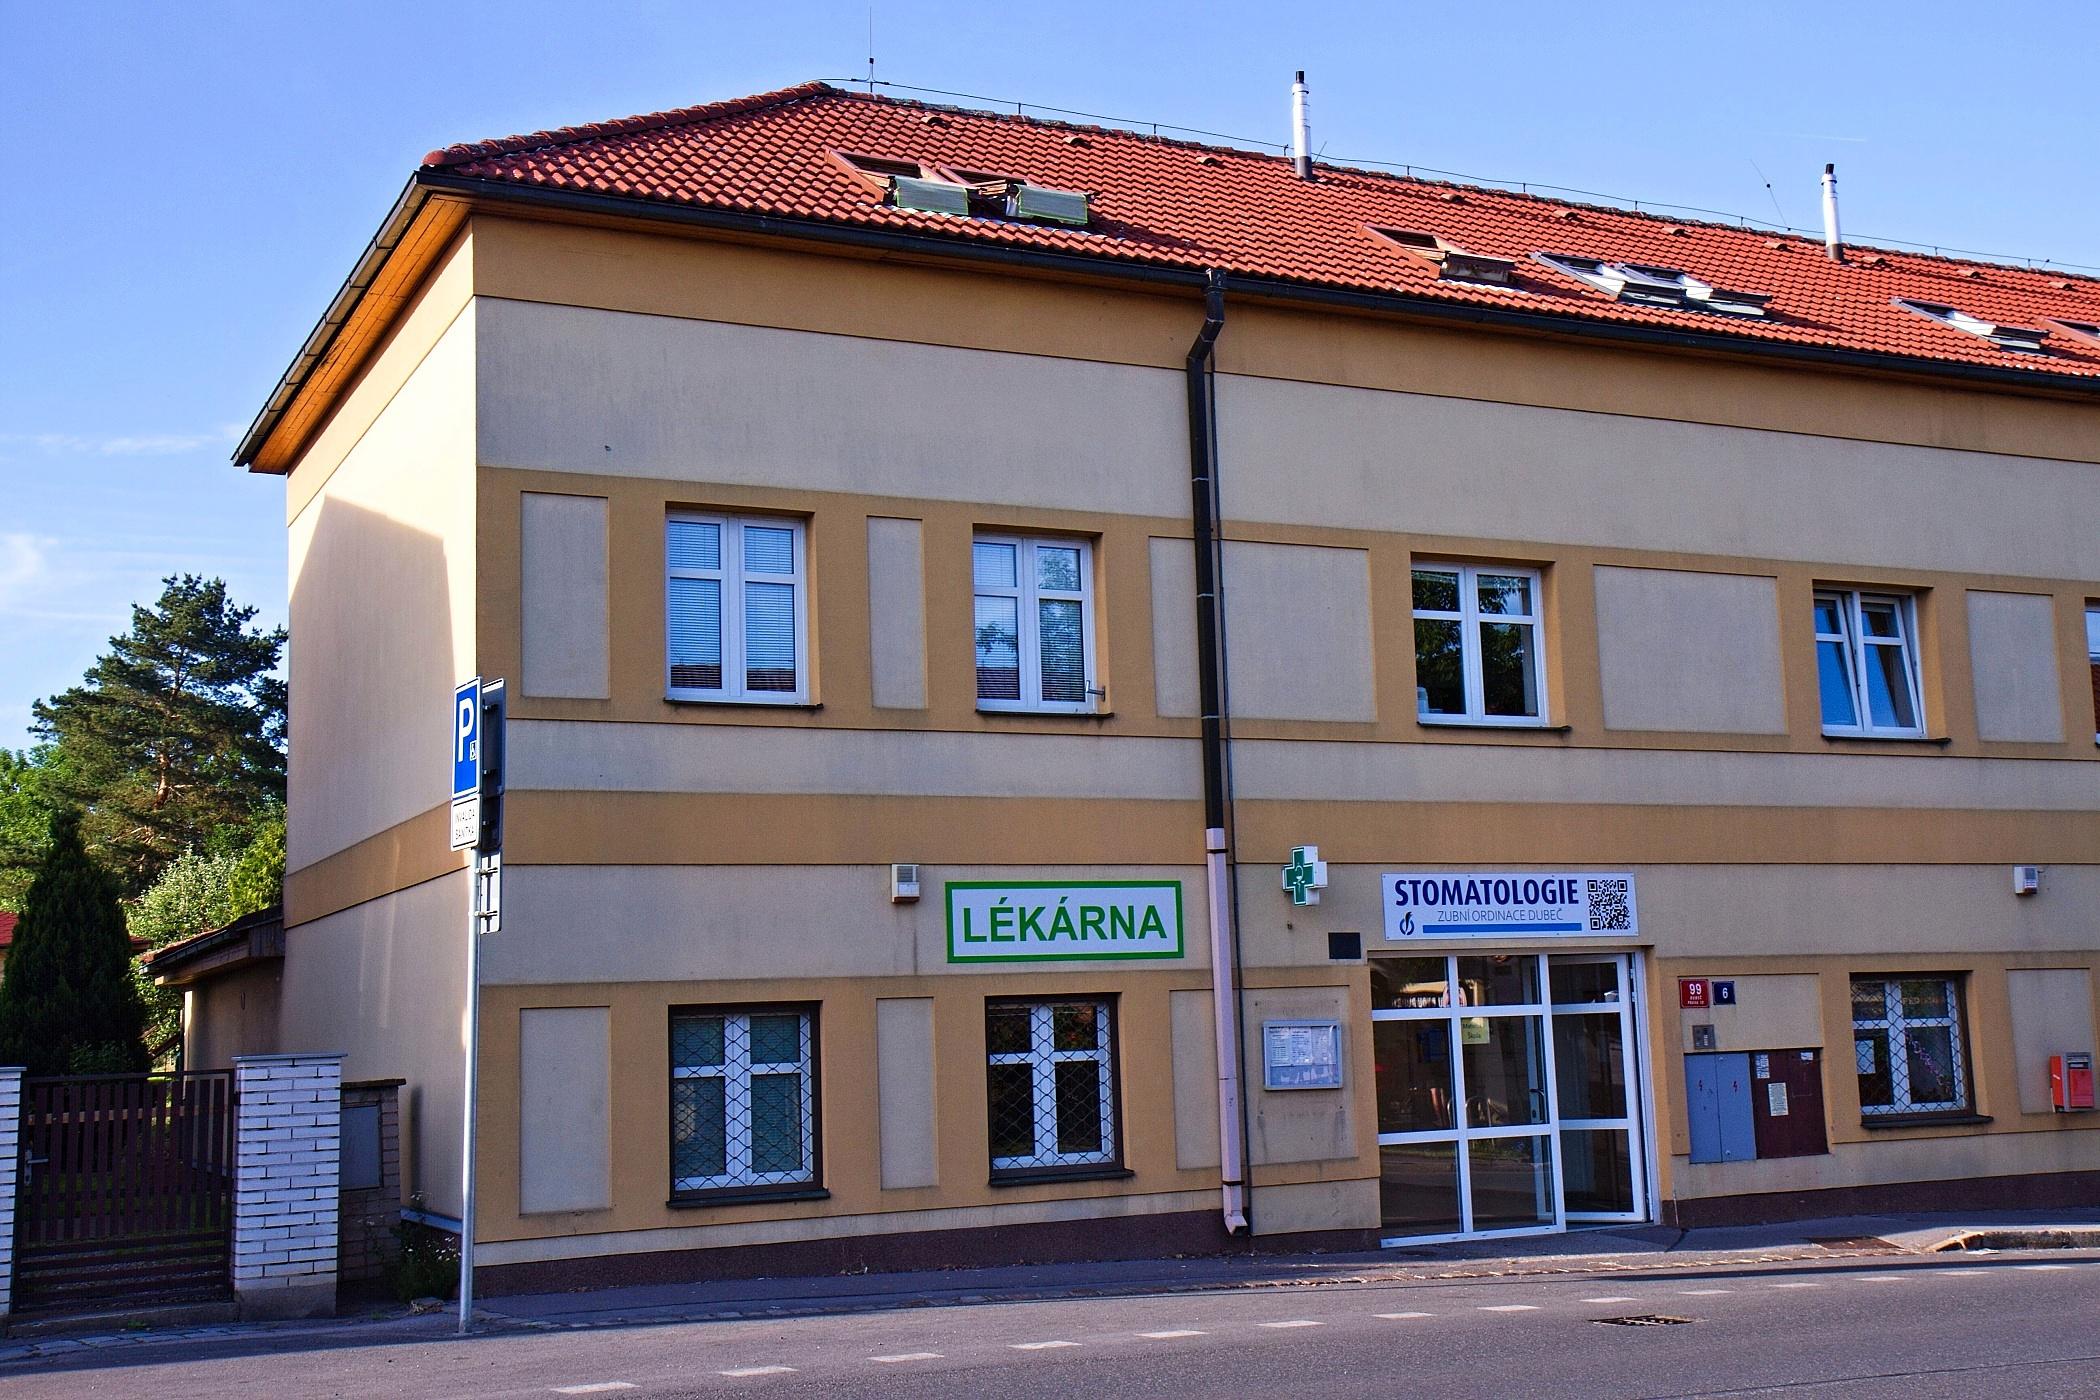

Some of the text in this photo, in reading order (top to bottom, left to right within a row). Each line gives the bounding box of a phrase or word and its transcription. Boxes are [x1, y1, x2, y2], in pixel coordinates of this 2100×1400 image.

[458, 697, 475, 763] P
[1394, 879, 1579, 906] STOMATOLOGIE
[963, 896, 1168, 943] LÉKÁRNA
[1437, 908, 1564, 922] ZUBNÍ ORDINACE DUBEČ
[1689, 983, 1702, 995] 99
[1722, 987, 1728, 999] 6
